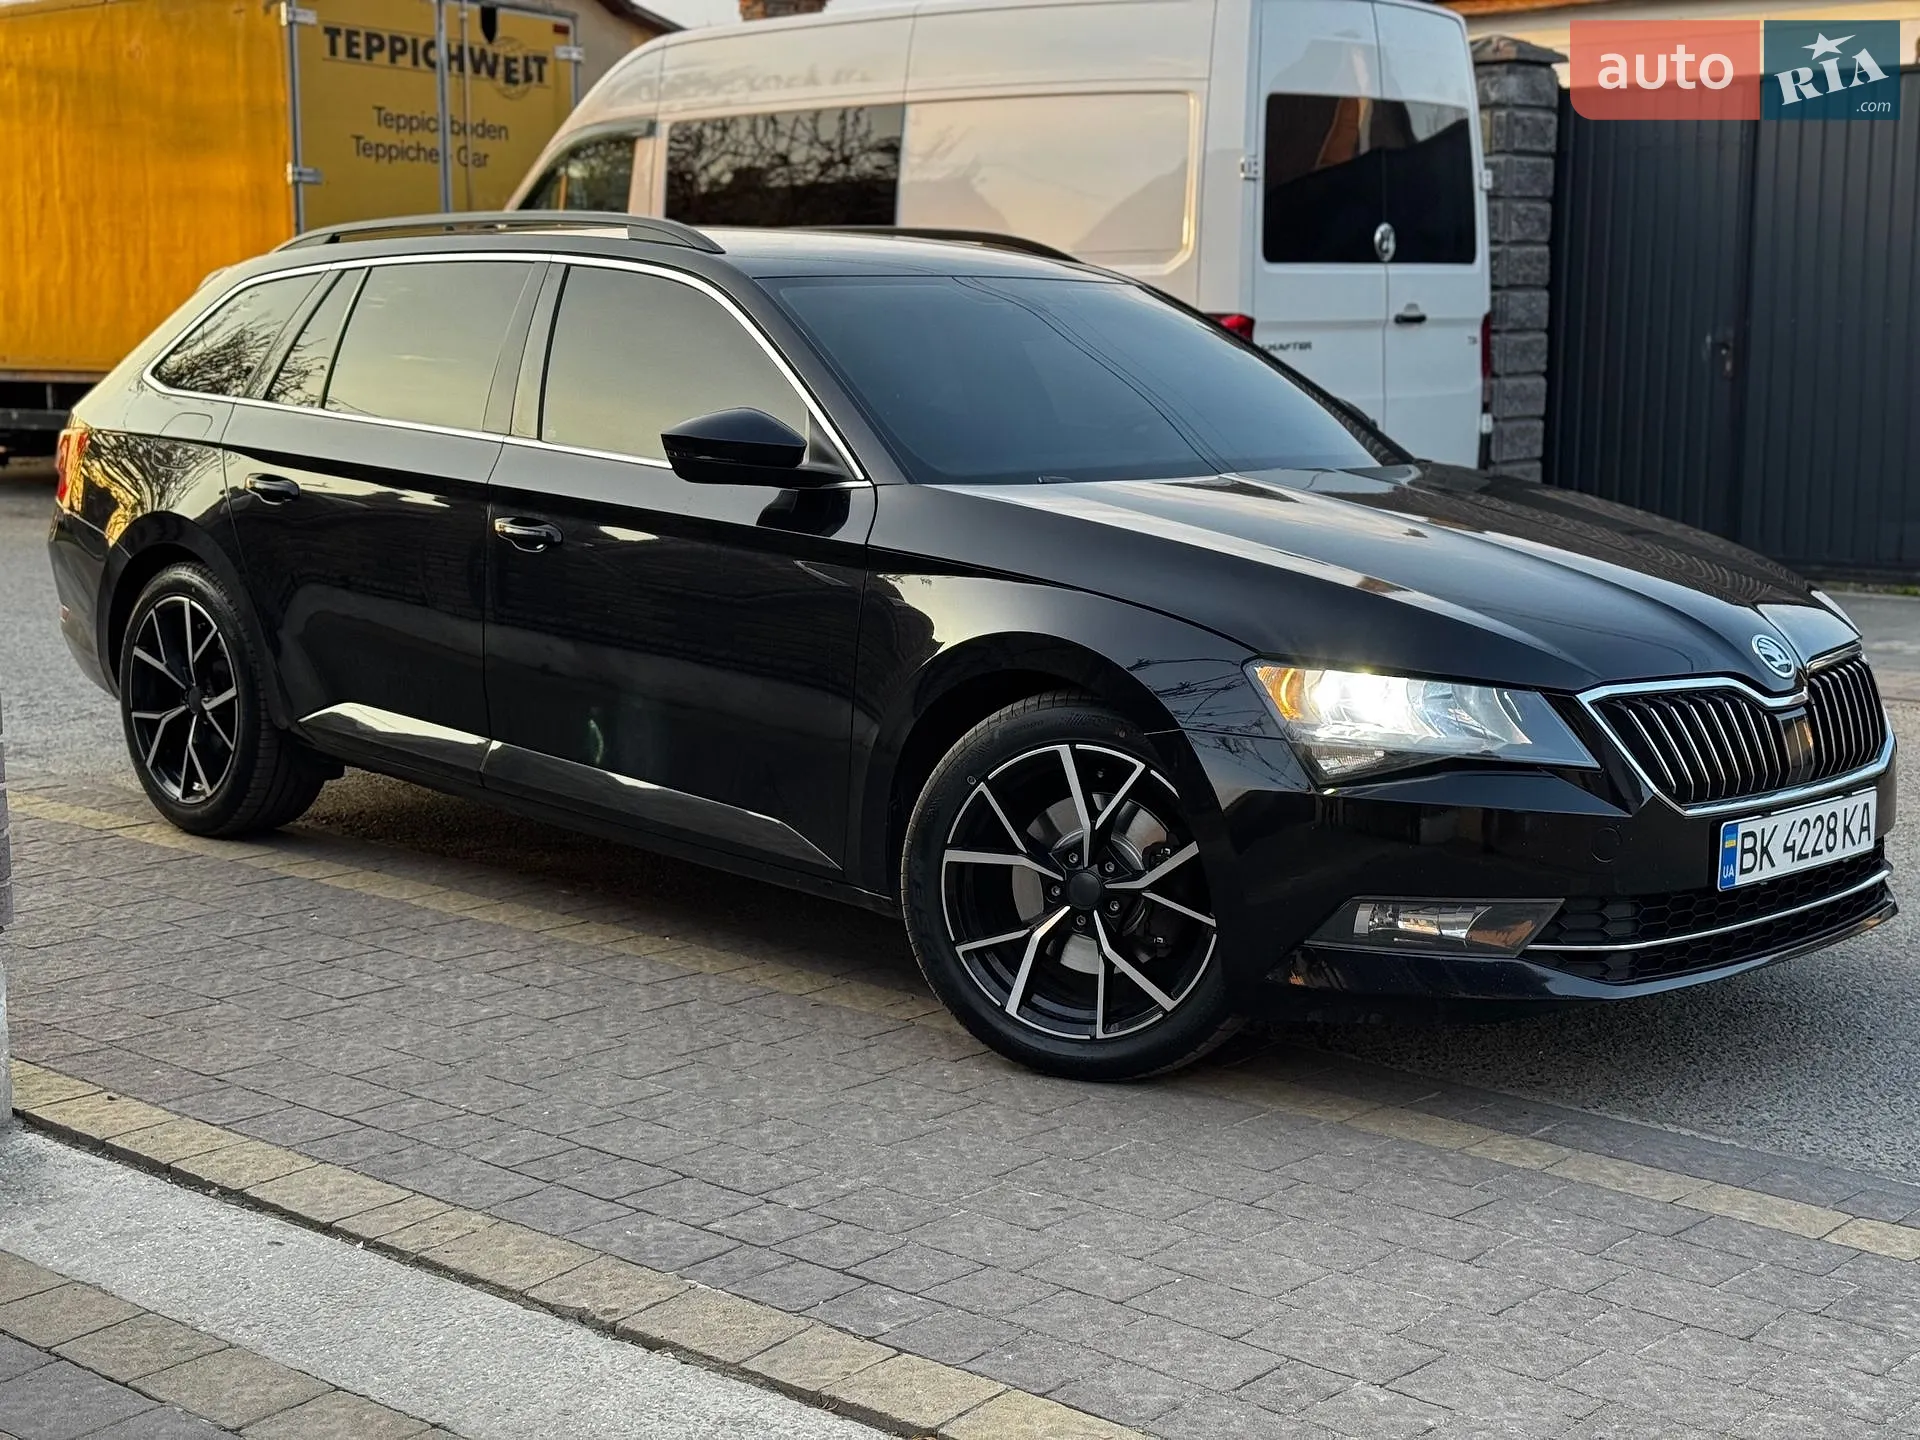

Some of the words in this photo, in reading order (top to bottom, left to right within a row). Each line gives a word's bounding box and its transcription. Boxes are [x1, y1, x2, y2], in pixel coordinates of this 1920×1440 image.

[1739, 823, 1778, 876] BK
[1782, 810, 1838, 864] 4228
[1842, 801, 1872, 850] KA
[1722, 864, 1735, 879] UA
